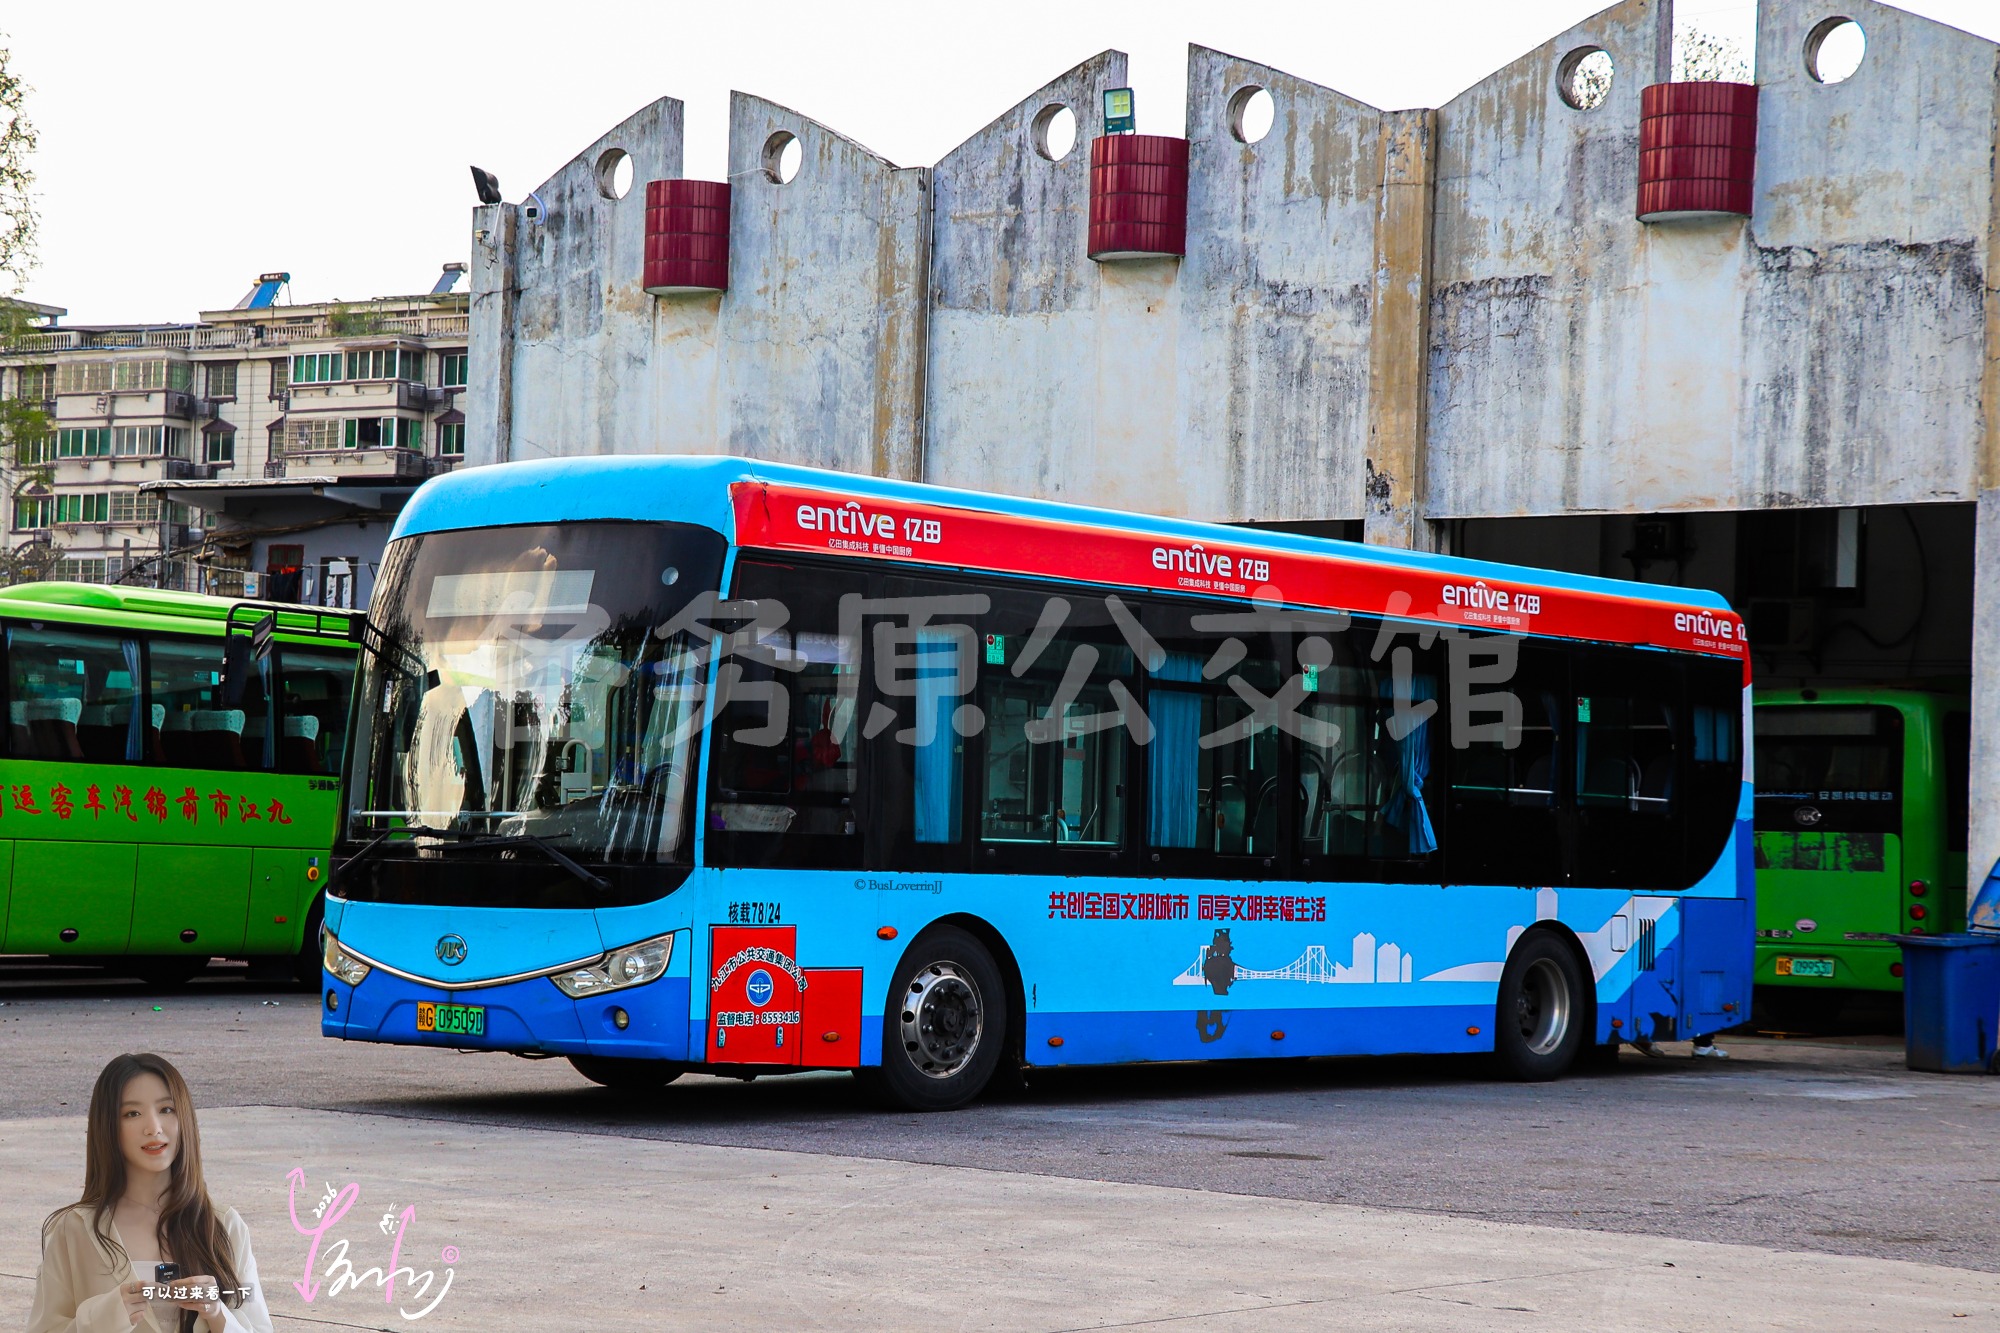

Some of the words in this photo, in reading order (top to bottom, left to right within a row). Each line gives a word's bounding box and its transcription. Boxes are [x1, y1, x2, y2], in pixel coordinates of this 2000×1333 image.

[903, 518, 941, 544] 亿田
[828, 538, 869, 552] 亿田集成科技
[872, 543, 912, 557] 更懂中国厨房
[1238, 558, 1269, 582] 亿田
[1514, 593, 1540, 615] 亿田
[728, 902, 781, 924] 核载78/24
[1048, 891, 1189, 920] 共创全国文明城市
[1198, 894, 1326, 922] 同享文明幸福生活
